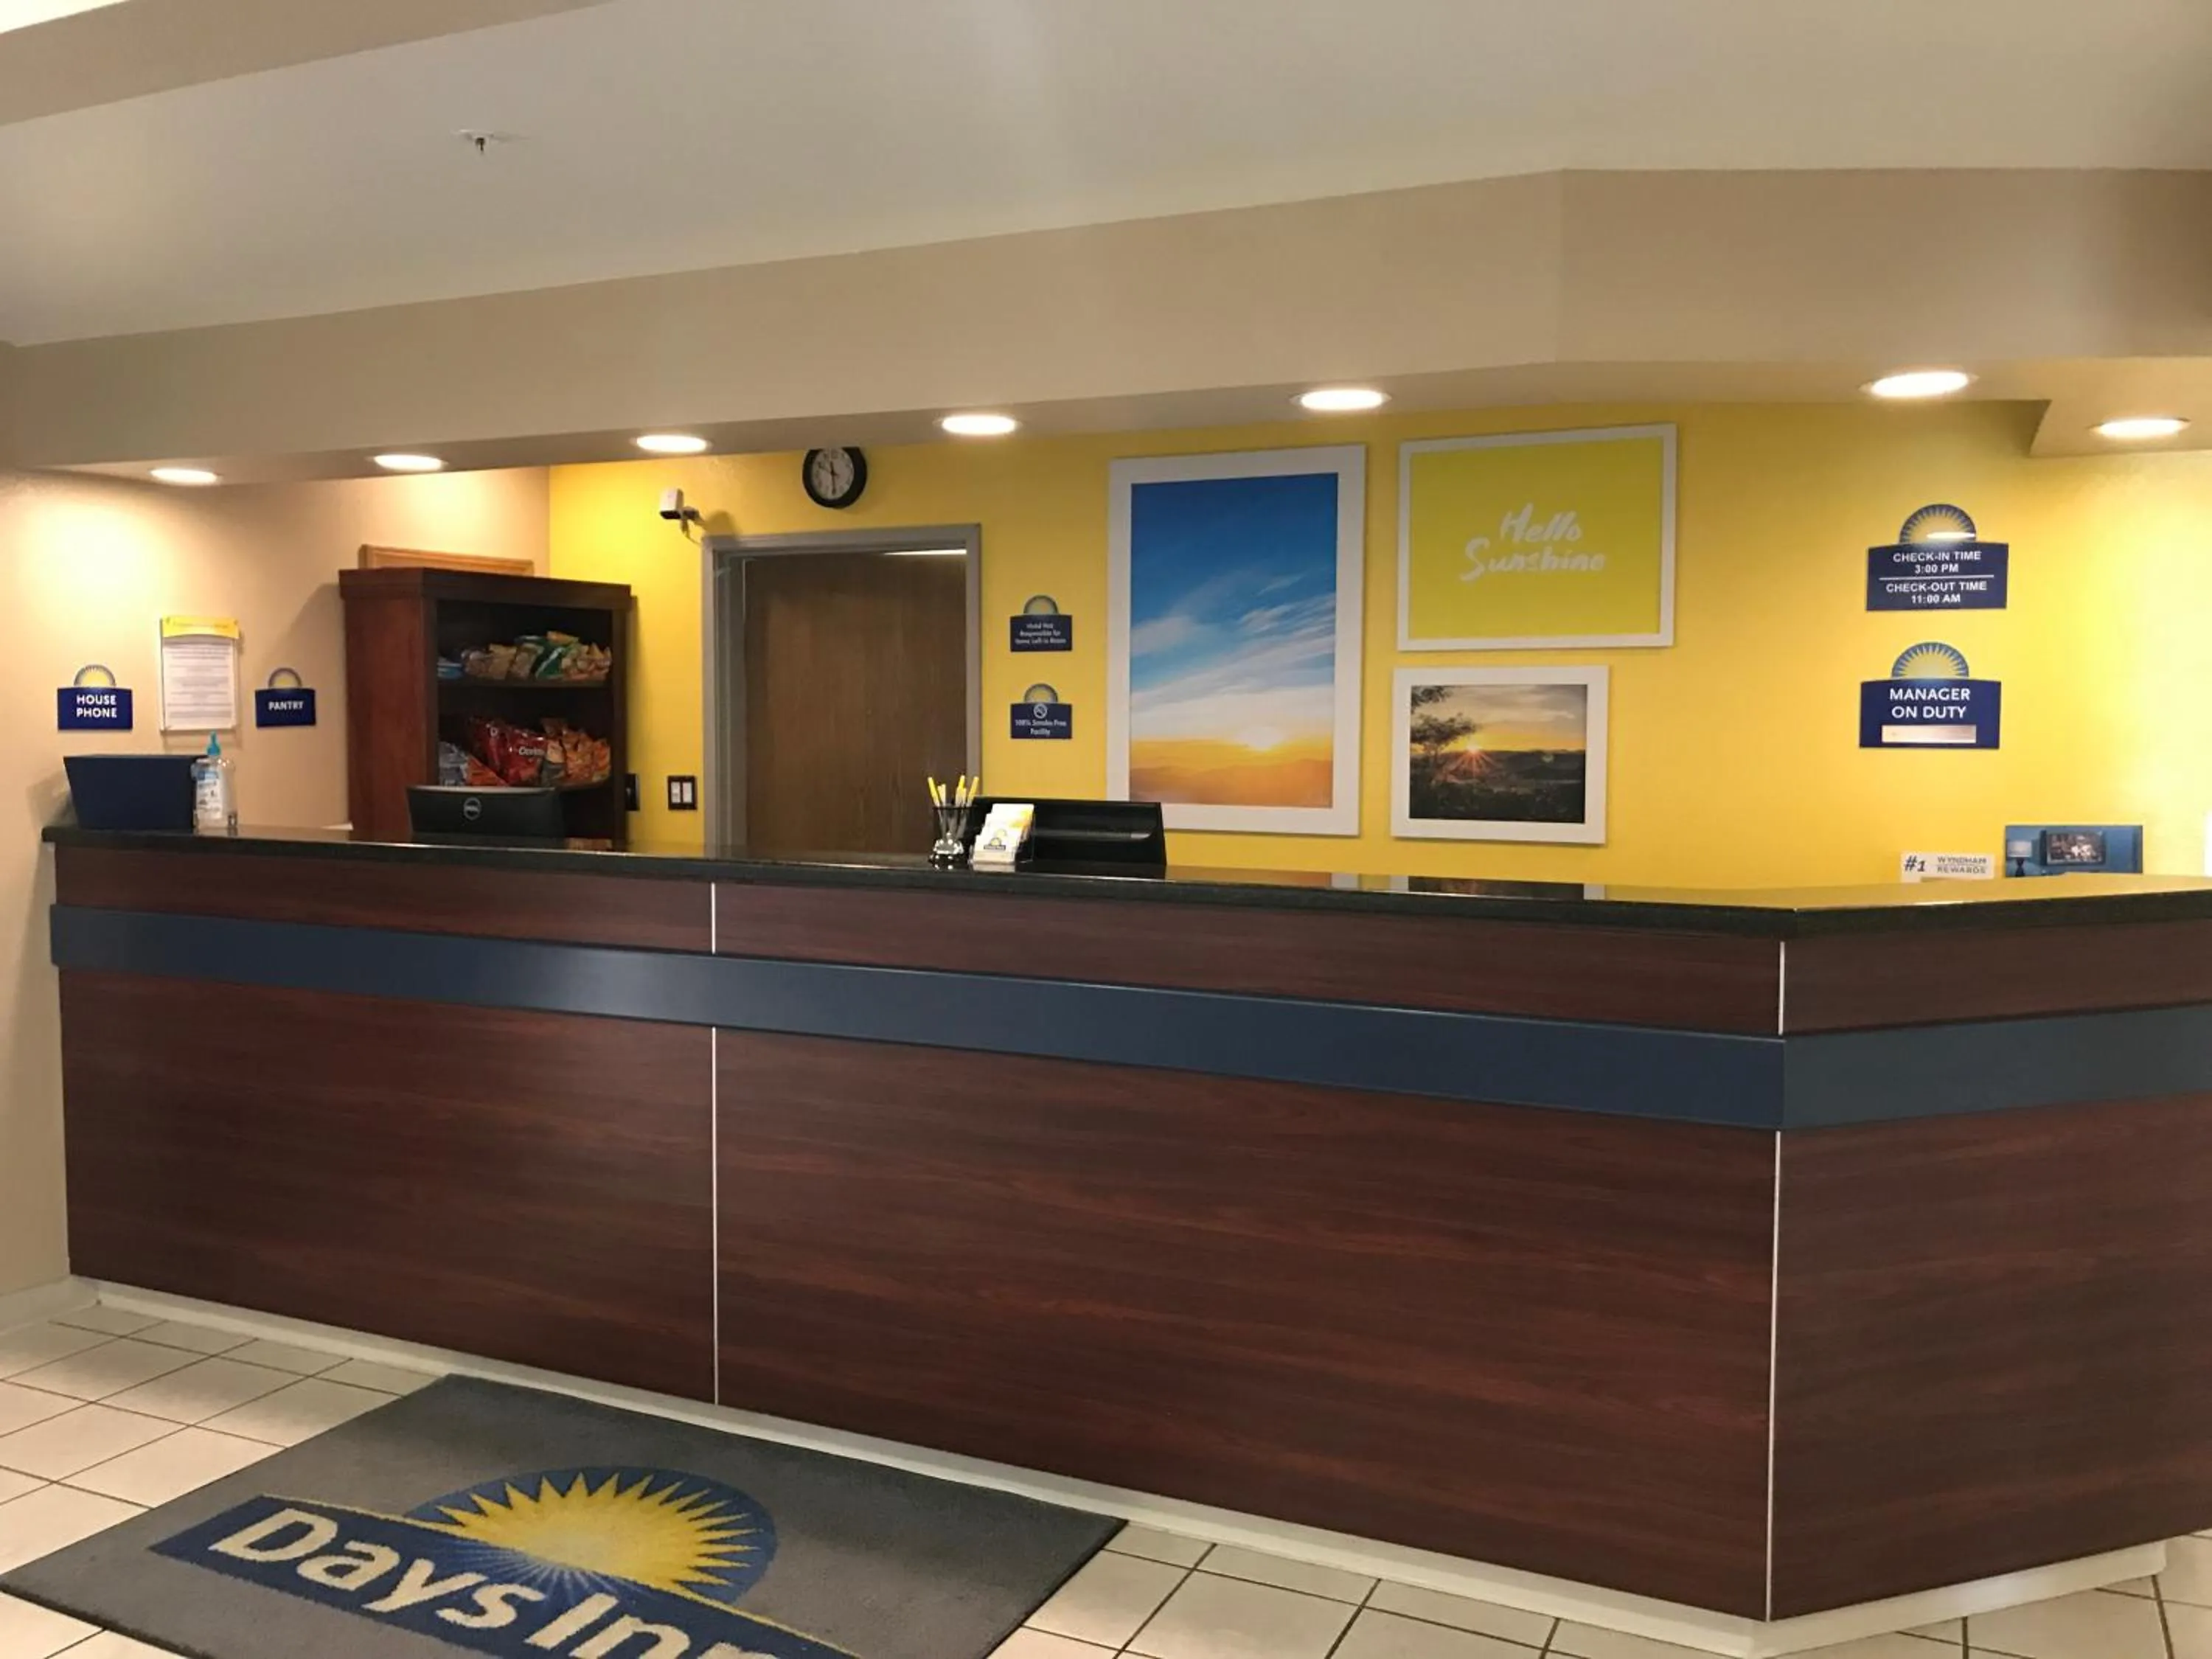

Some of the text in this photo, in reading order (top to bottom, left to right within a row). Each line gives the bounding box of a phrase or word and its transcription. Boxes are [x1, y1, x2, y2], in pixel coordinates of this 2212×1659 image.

[1500, 502, 1582, 543] Hello
[1459, 537, 1605, 582] Sunshine
[1893, 551, 1982, 563] CHECK-IN TIME
[1915, 563, 1959, 574] 3:00 PM
[1885, 581, 1987, 593] CHECK-OUT TIME
[1911, 594, 1961, 604] 11:00 AM
[76, 695, 117, 705] HOUSE
[1890, 688, 1970, 700] MANAGER
[268, 700, 304, 710] PANTRY
[76, 708, 117, 717] PHONE
[1891, 706, 1966, 718] ON DUTY
[1905, 855, 1925, 872] #1
[208, 1508, 782, 1659] Days In
